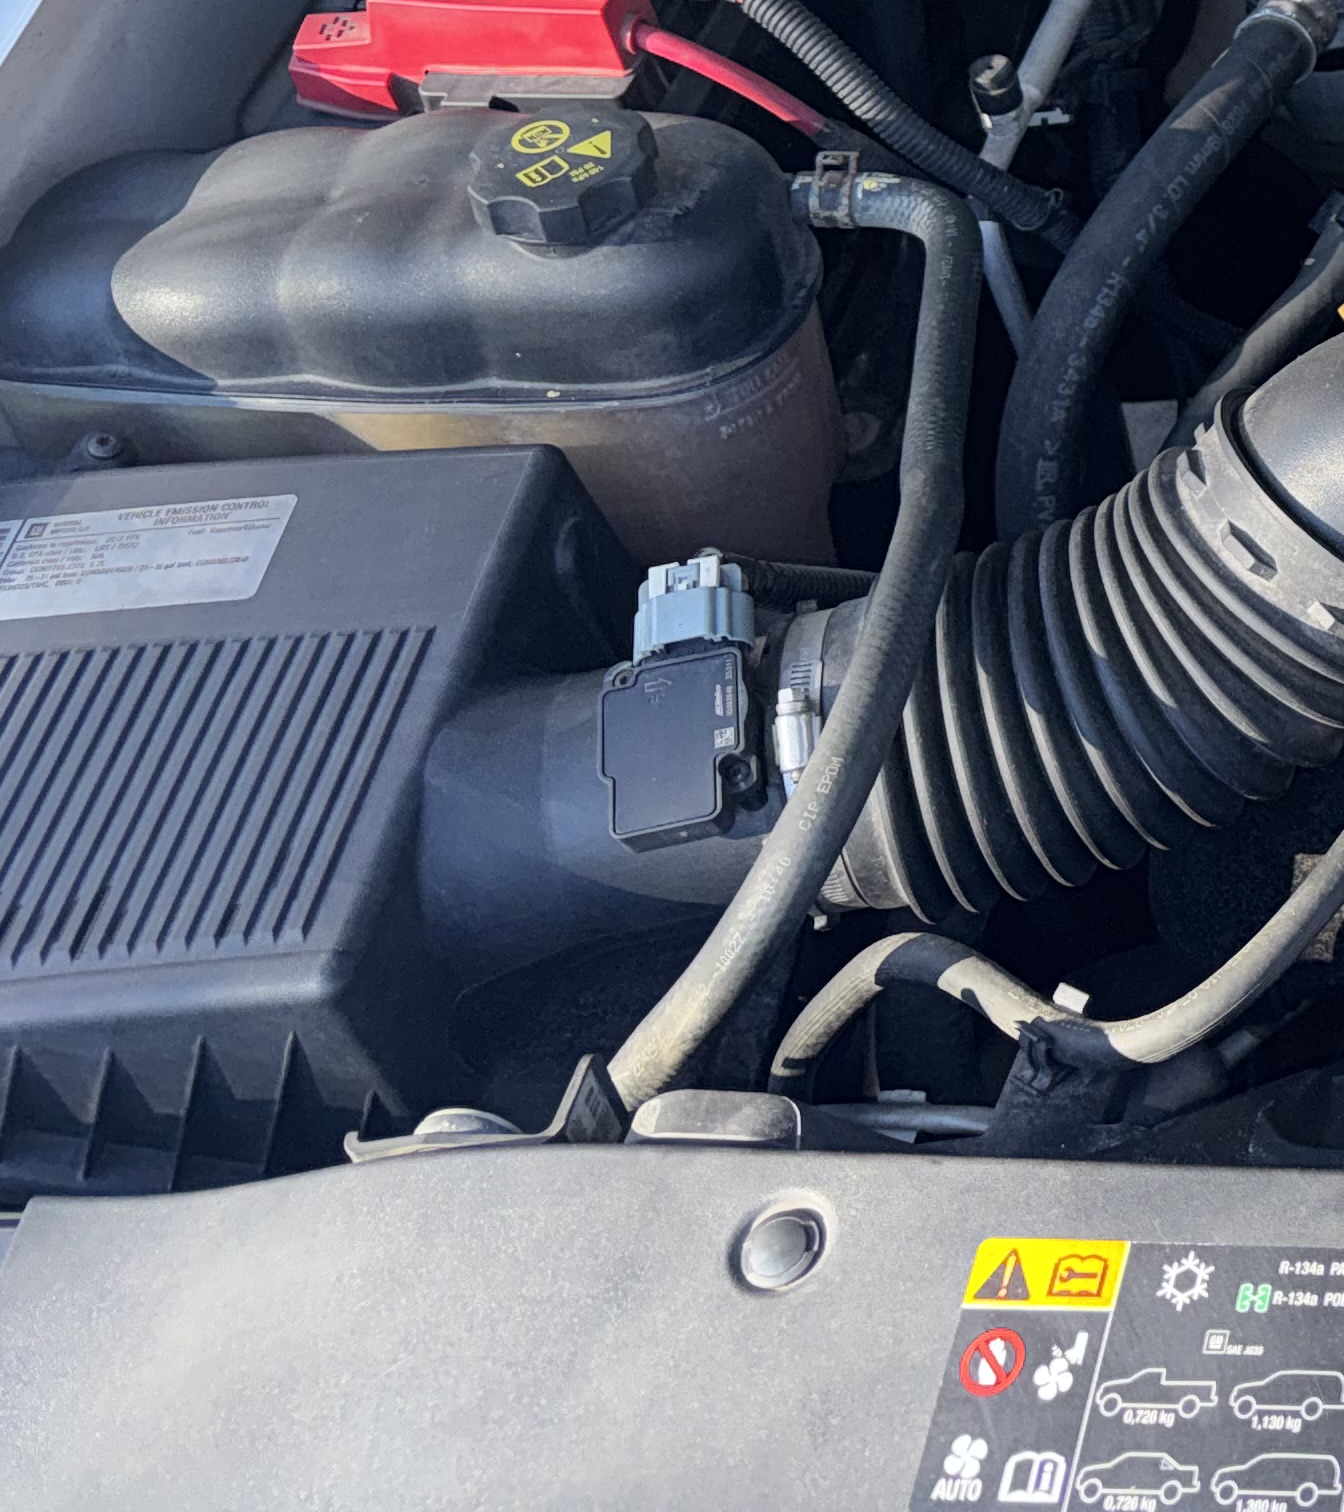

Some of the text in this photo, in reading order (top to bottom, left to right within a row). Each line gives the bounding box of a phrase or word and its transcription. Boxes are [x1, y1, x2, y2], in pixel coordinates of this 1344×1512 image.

[117, 499, 271, 521] VEHICLE EMISSION CONTROL
[152, 511, 232, 527] INFORMATION
[797, 801, 821, 833] CIP
[816, 756, 846, 796] EPDM
[1278, 1260, 1325, 1276] R-134a
[1272, 1291, 1318, 1306] R-134a
[1158, 1410, 1176, 1428] kg
[1250, 1414, 1303, 1433] 1,130 kg
[931, 1478, 983, 1502] AUTO
[1139, 1496, 1157, 1512] kg
